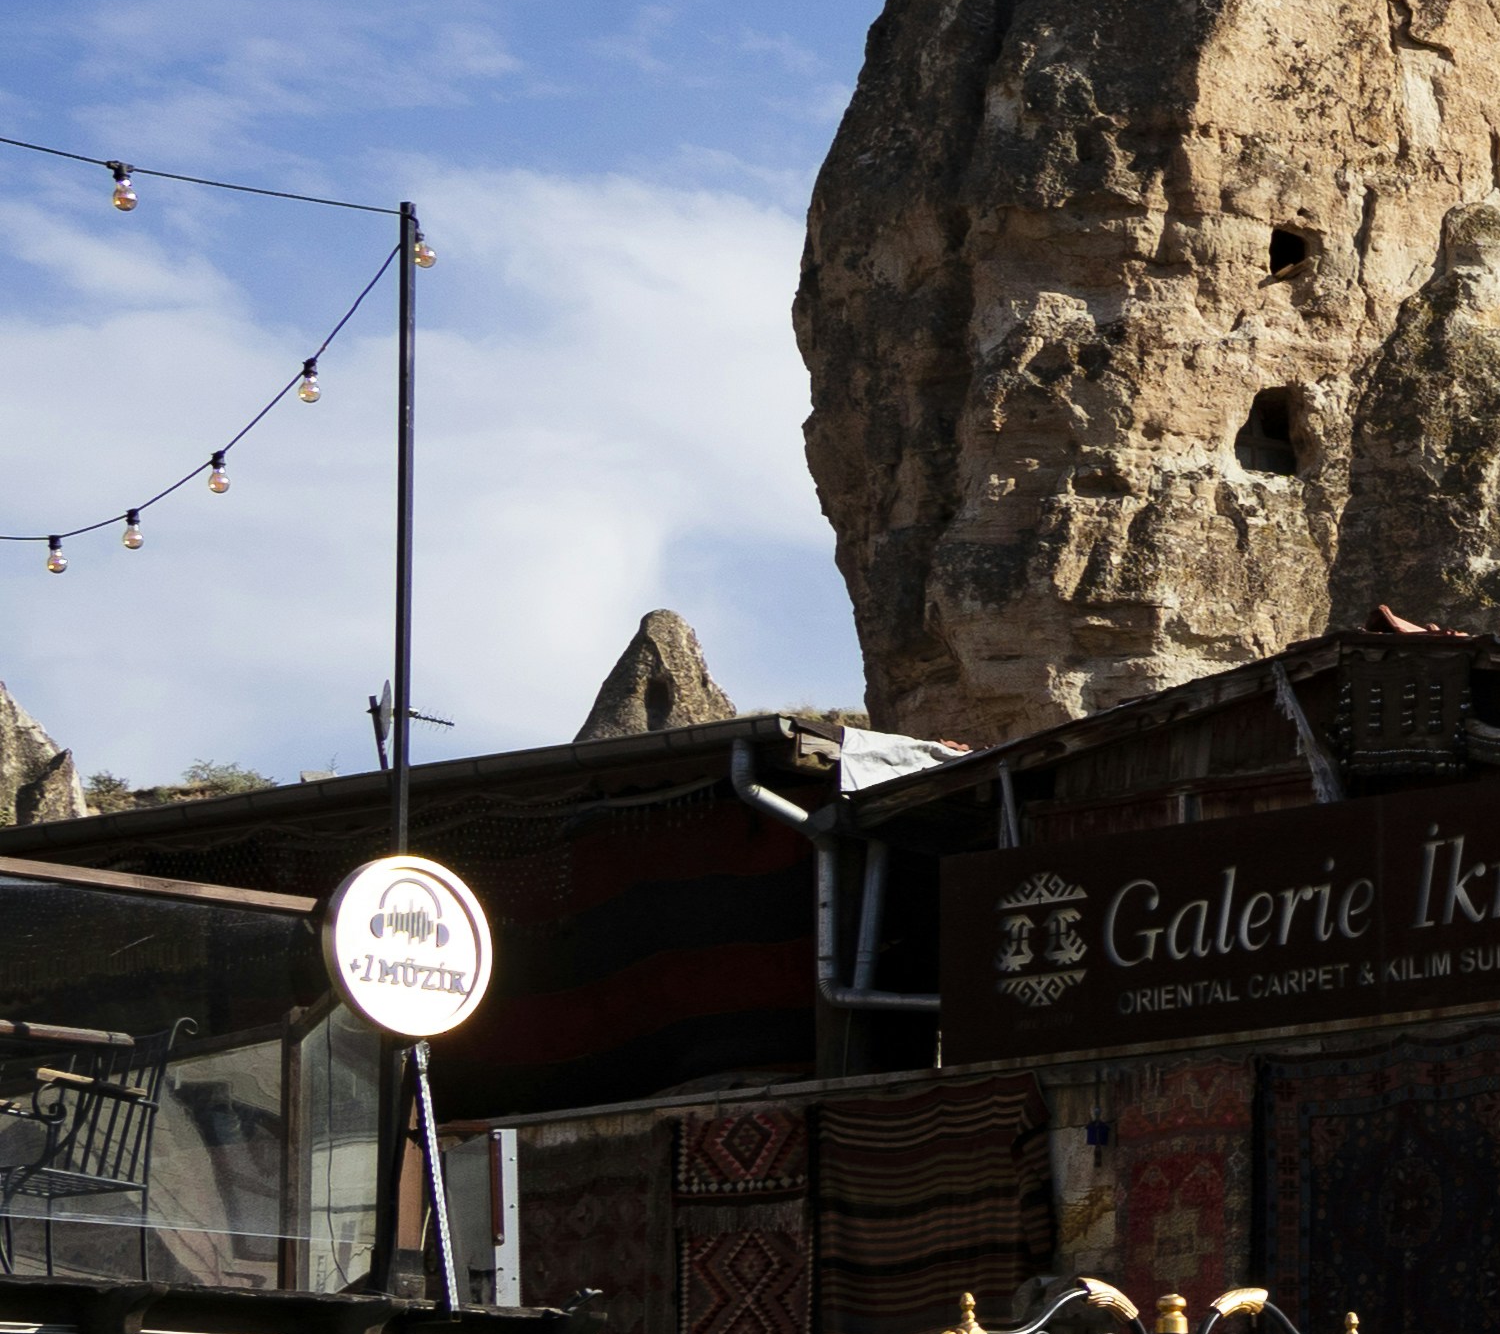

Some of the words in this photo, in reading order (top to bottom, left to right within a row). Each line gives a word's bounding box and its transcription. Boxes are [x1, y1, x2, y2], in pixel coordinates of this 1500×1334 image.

[1103, 856, 1375, 967] Galerie
[350, 954, 374, 982] +1
[377, 957, 468, 996] MÜZİK
[1117, 980, 1240, 1015] ORIENTAL
[1249, 963, 1350, 1000] CARPET
[1359, 962, 1376, 987] &
[1384, 951, 1451, 983] KILIM
